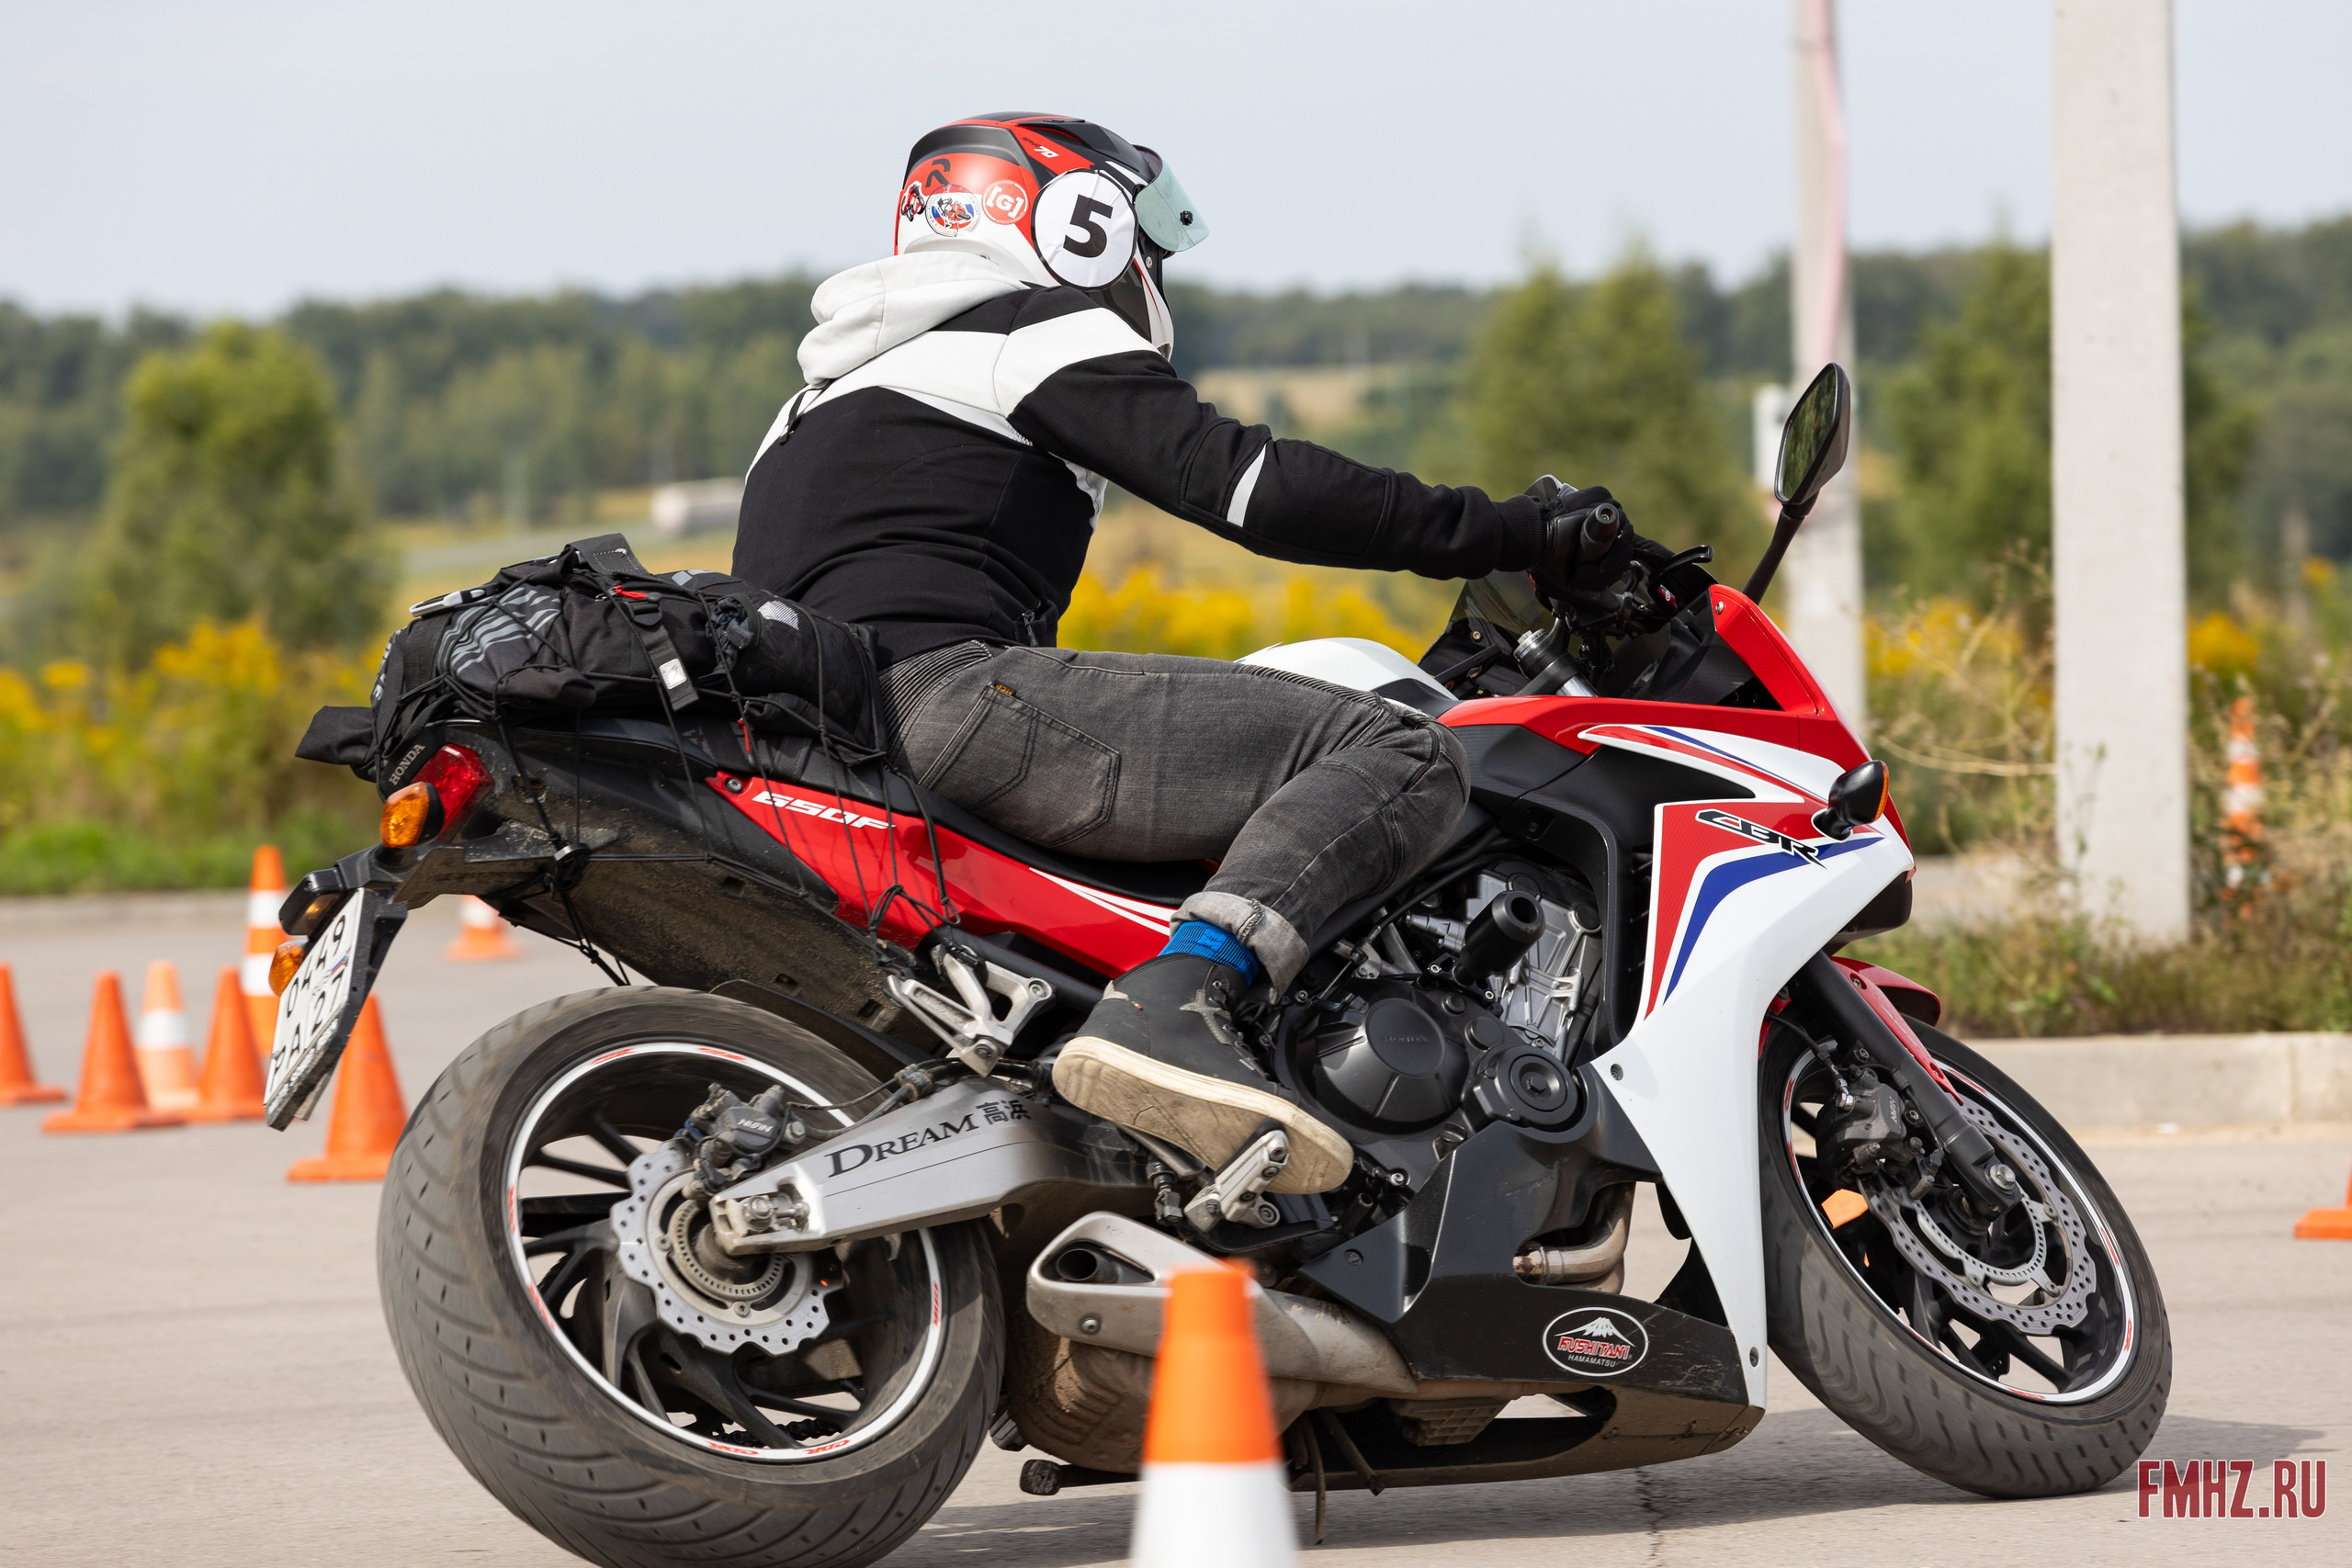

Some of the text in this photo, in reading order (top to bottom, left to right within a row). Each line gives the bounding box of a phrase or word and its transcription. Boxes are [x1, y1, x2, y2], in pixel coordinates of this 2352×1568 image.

[1063, 194, 1114, 258] 5
[388, 744, 425, 785] HONDA
[752, 791, 897, 829] 650F
[1695, 808, 1827, 870] CBR
[824, 1100, 1032, 1178] DREAM 高浜
[1557, 1336, 1631, 1359] KUSHITANI
[1567, 1354, 1617, 1368] HAMAMATSU
